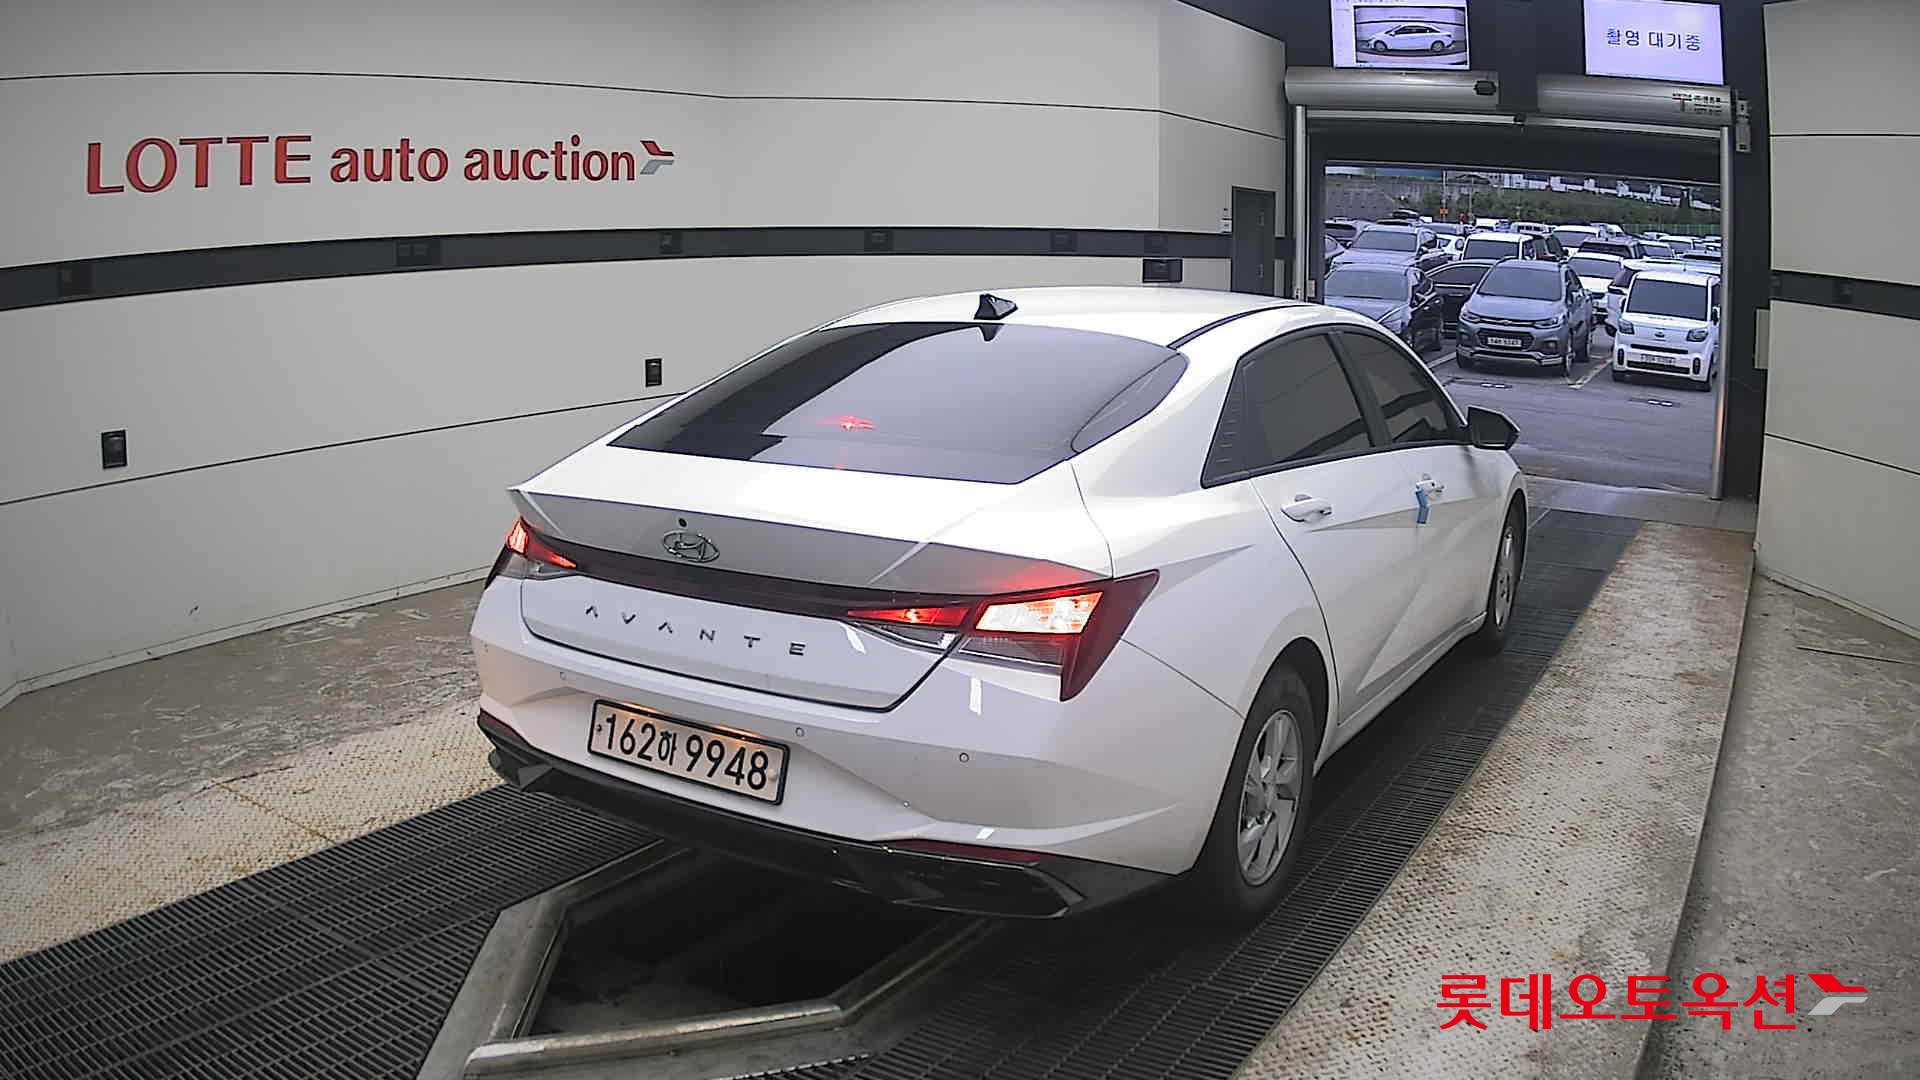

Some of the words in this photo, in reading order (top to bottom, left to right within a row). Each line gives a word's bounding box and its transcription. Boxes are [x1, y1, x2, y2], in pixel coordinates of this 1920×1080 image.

[1648, 31, 1702, 52] 대기중
[87, 135, 312, 195] LOTTE
[329, 138, 449, 183] auto
[463, 134, 636, 182] auction
[585, 605, 807, 657] AVANTE
[605, 713, 678, 766] 162하
[685, 733, 770, 791] 9948
